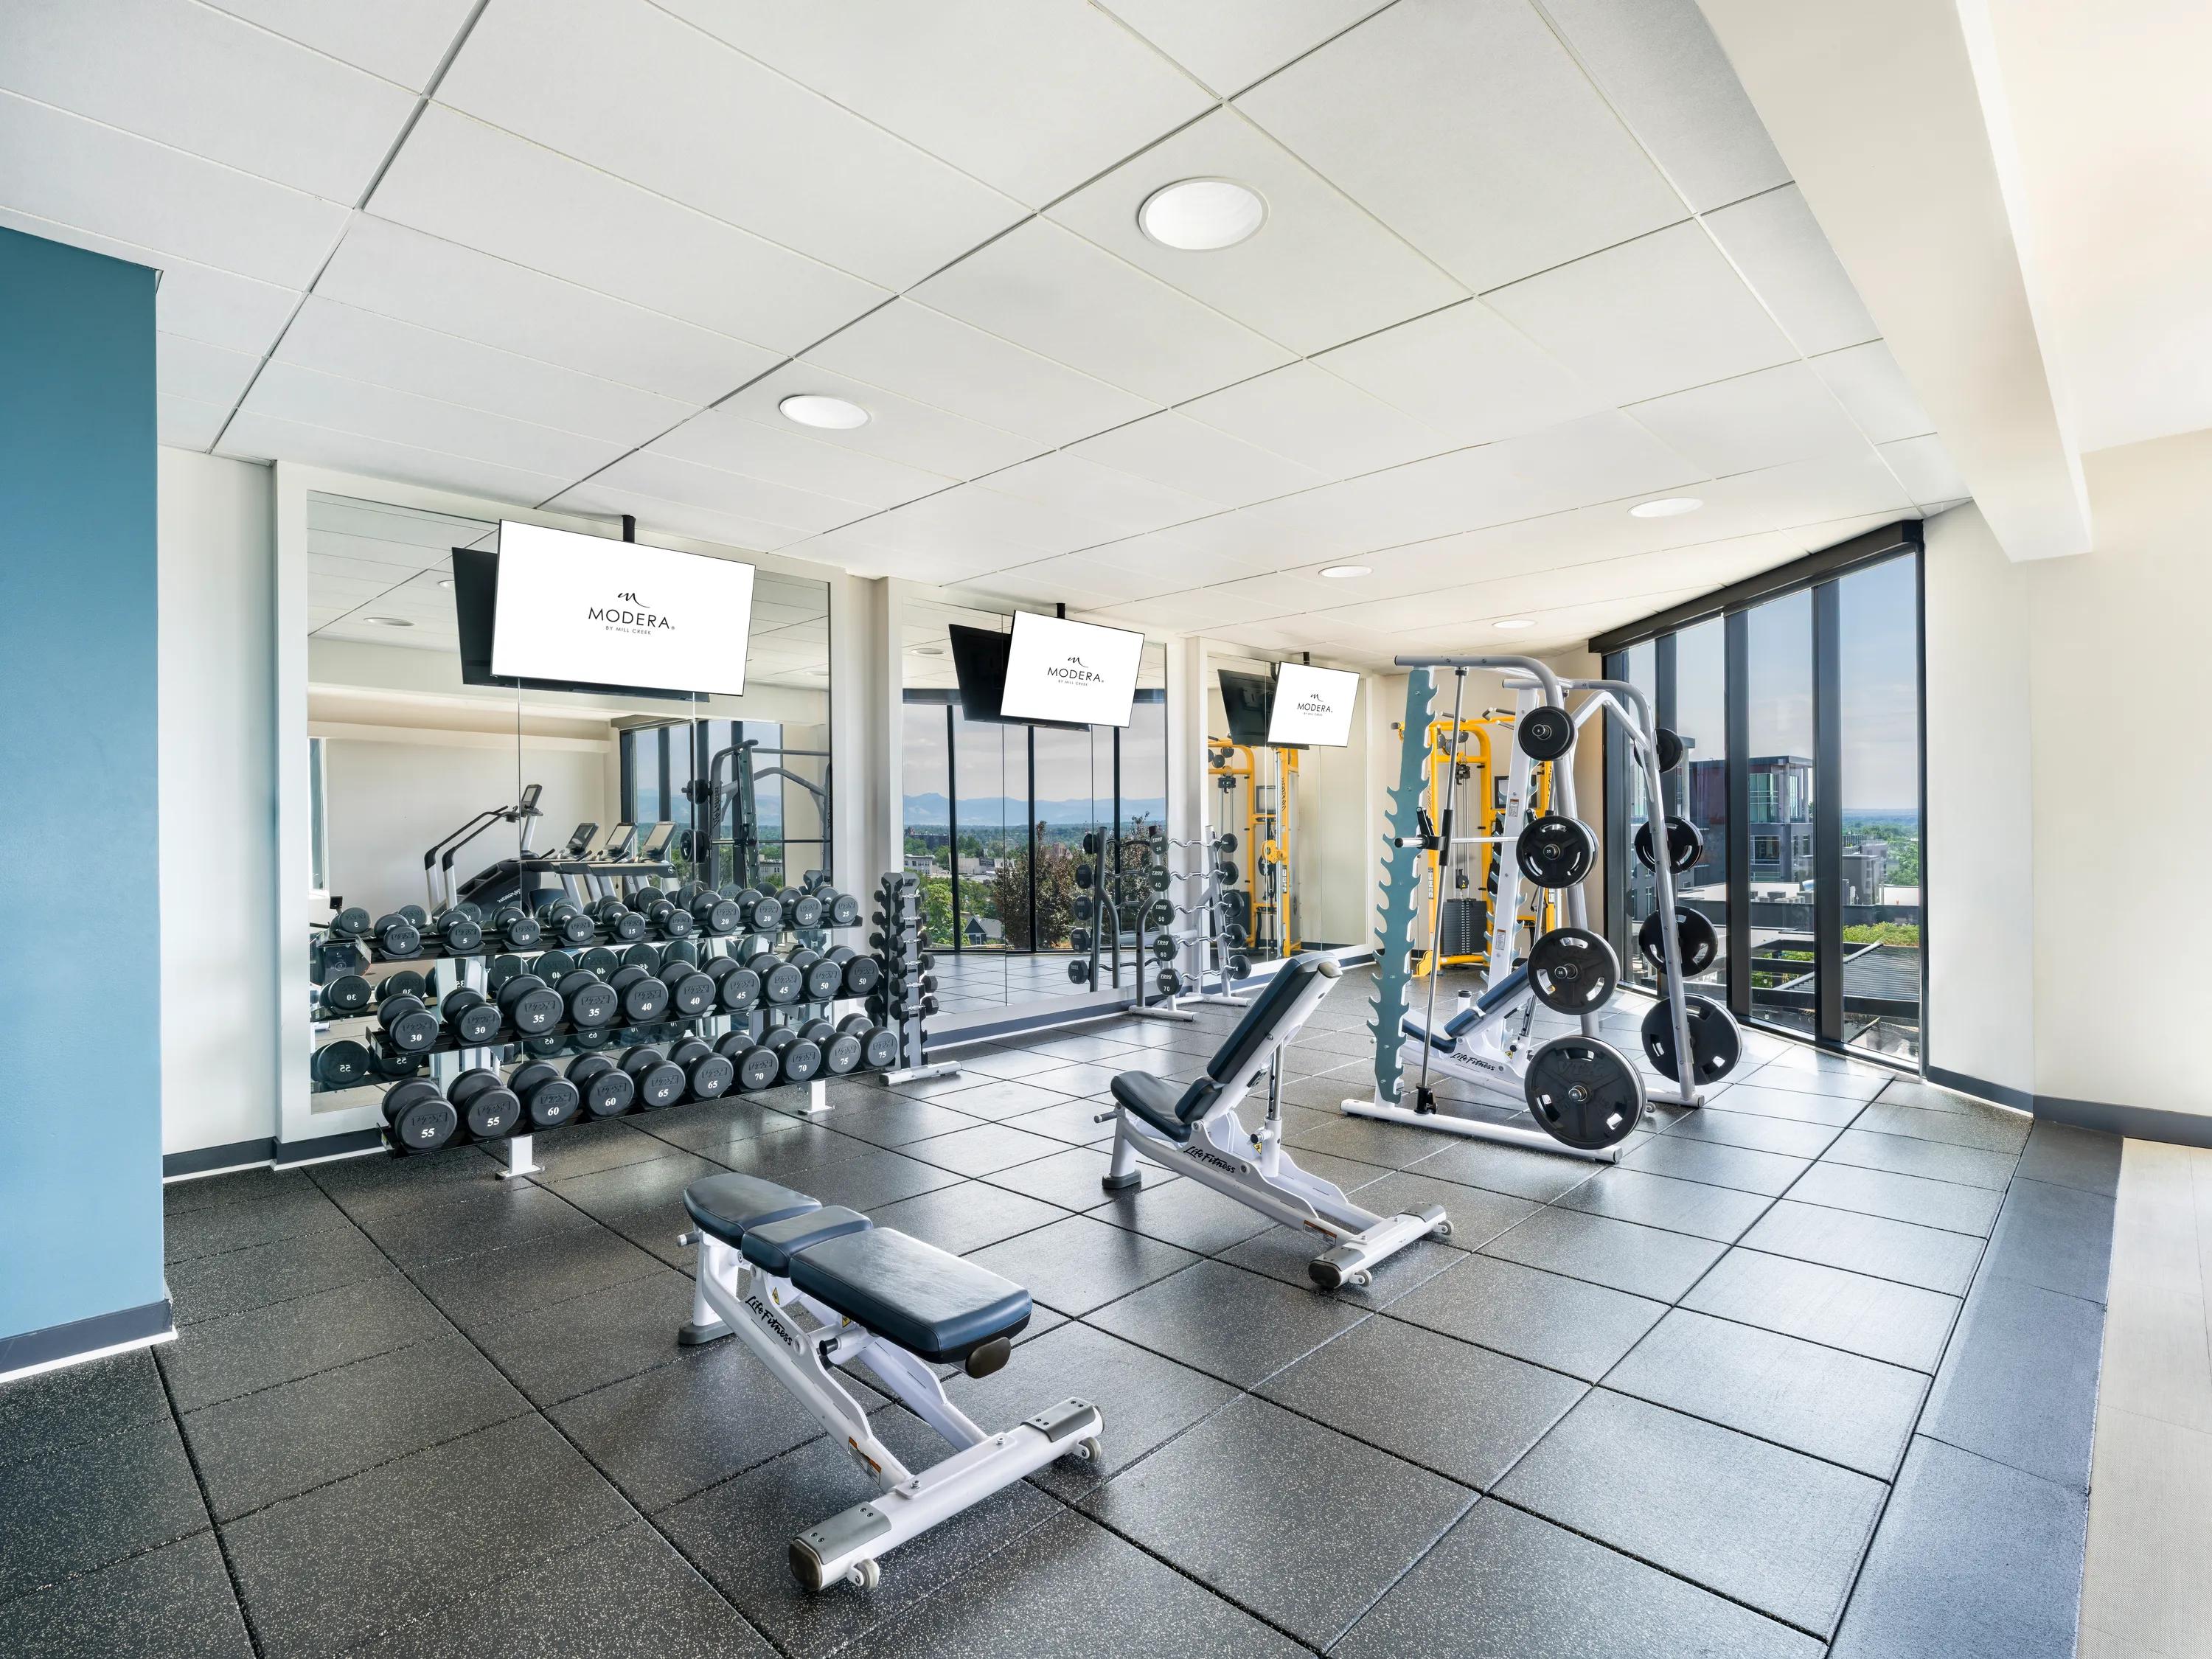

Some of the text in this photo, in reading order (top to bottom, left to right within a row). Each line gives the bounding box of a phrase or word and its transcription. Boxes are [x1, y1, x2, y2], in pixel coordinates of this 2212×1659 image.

[737, 992, 746, 1000] 45
[641, 1003, 653, 1011] 40
[588, 1009, 600, 1017] 35
[532, 1015, 545, 1023] 35
[474, 1026, 486, 1034] 30
[410, 1034, 422, 1043] 30
[840, 1057, 849, 1065] 75
[754, 1073, 764, 1081] 70
[707, 1081, 718, 1089] 65
[658, 1089, 669, 1098] 65
[605, 1098, 616, 1107] 60
[547, 1107, 560, 1116] 60
[487, 1117, 500, 1127] 55
[421, 1128, 435, 1138] 55
